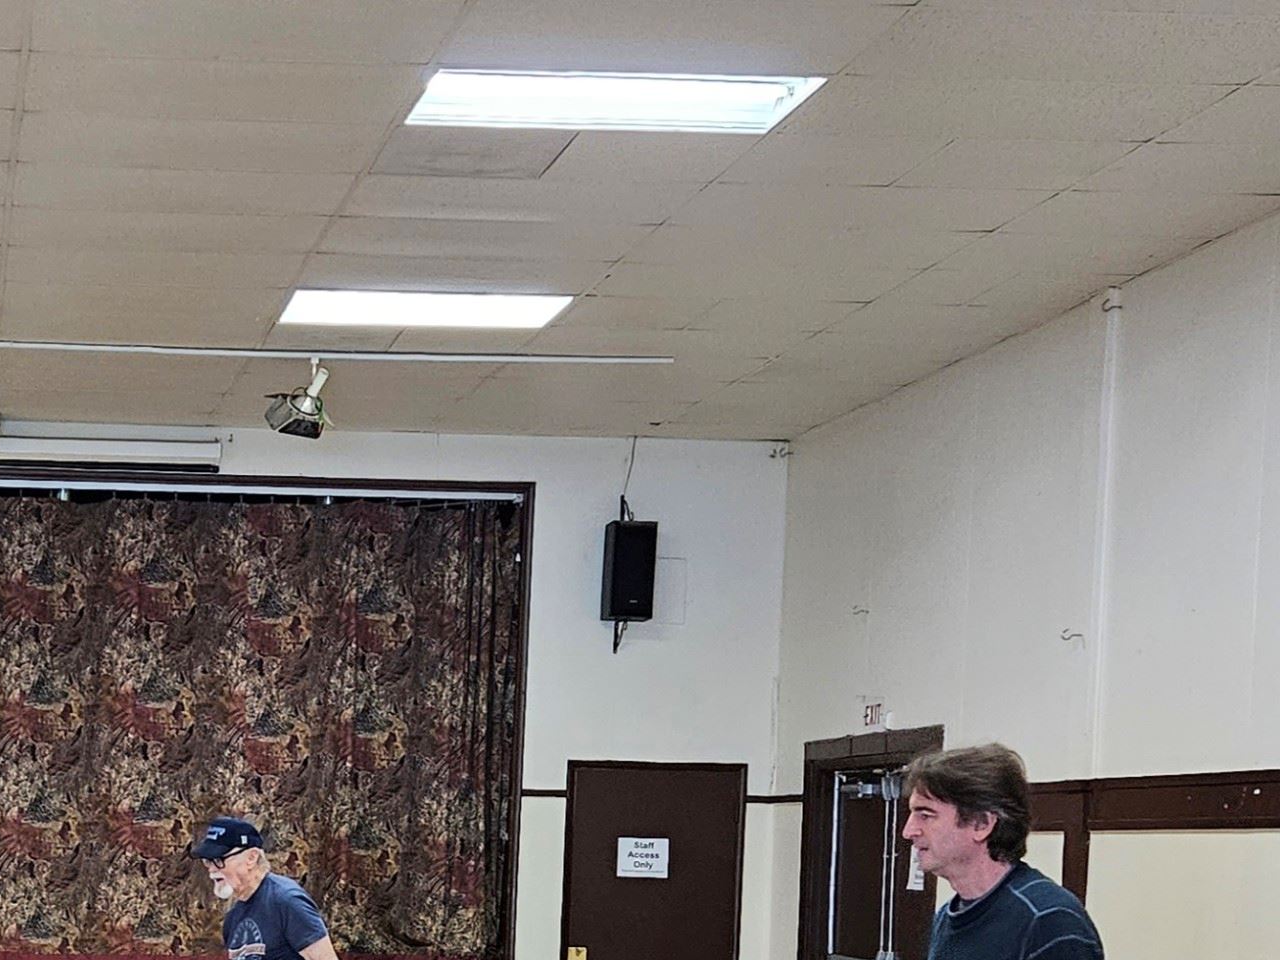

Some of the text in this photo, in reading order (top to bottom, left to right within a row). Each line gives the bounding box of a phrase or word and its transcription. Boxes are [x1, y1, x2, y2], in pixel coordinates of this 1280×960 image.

[634, 841, 655, 849] Staff
[627, 851, 660, 859] Access
[633, 860, 654, 870] Only
